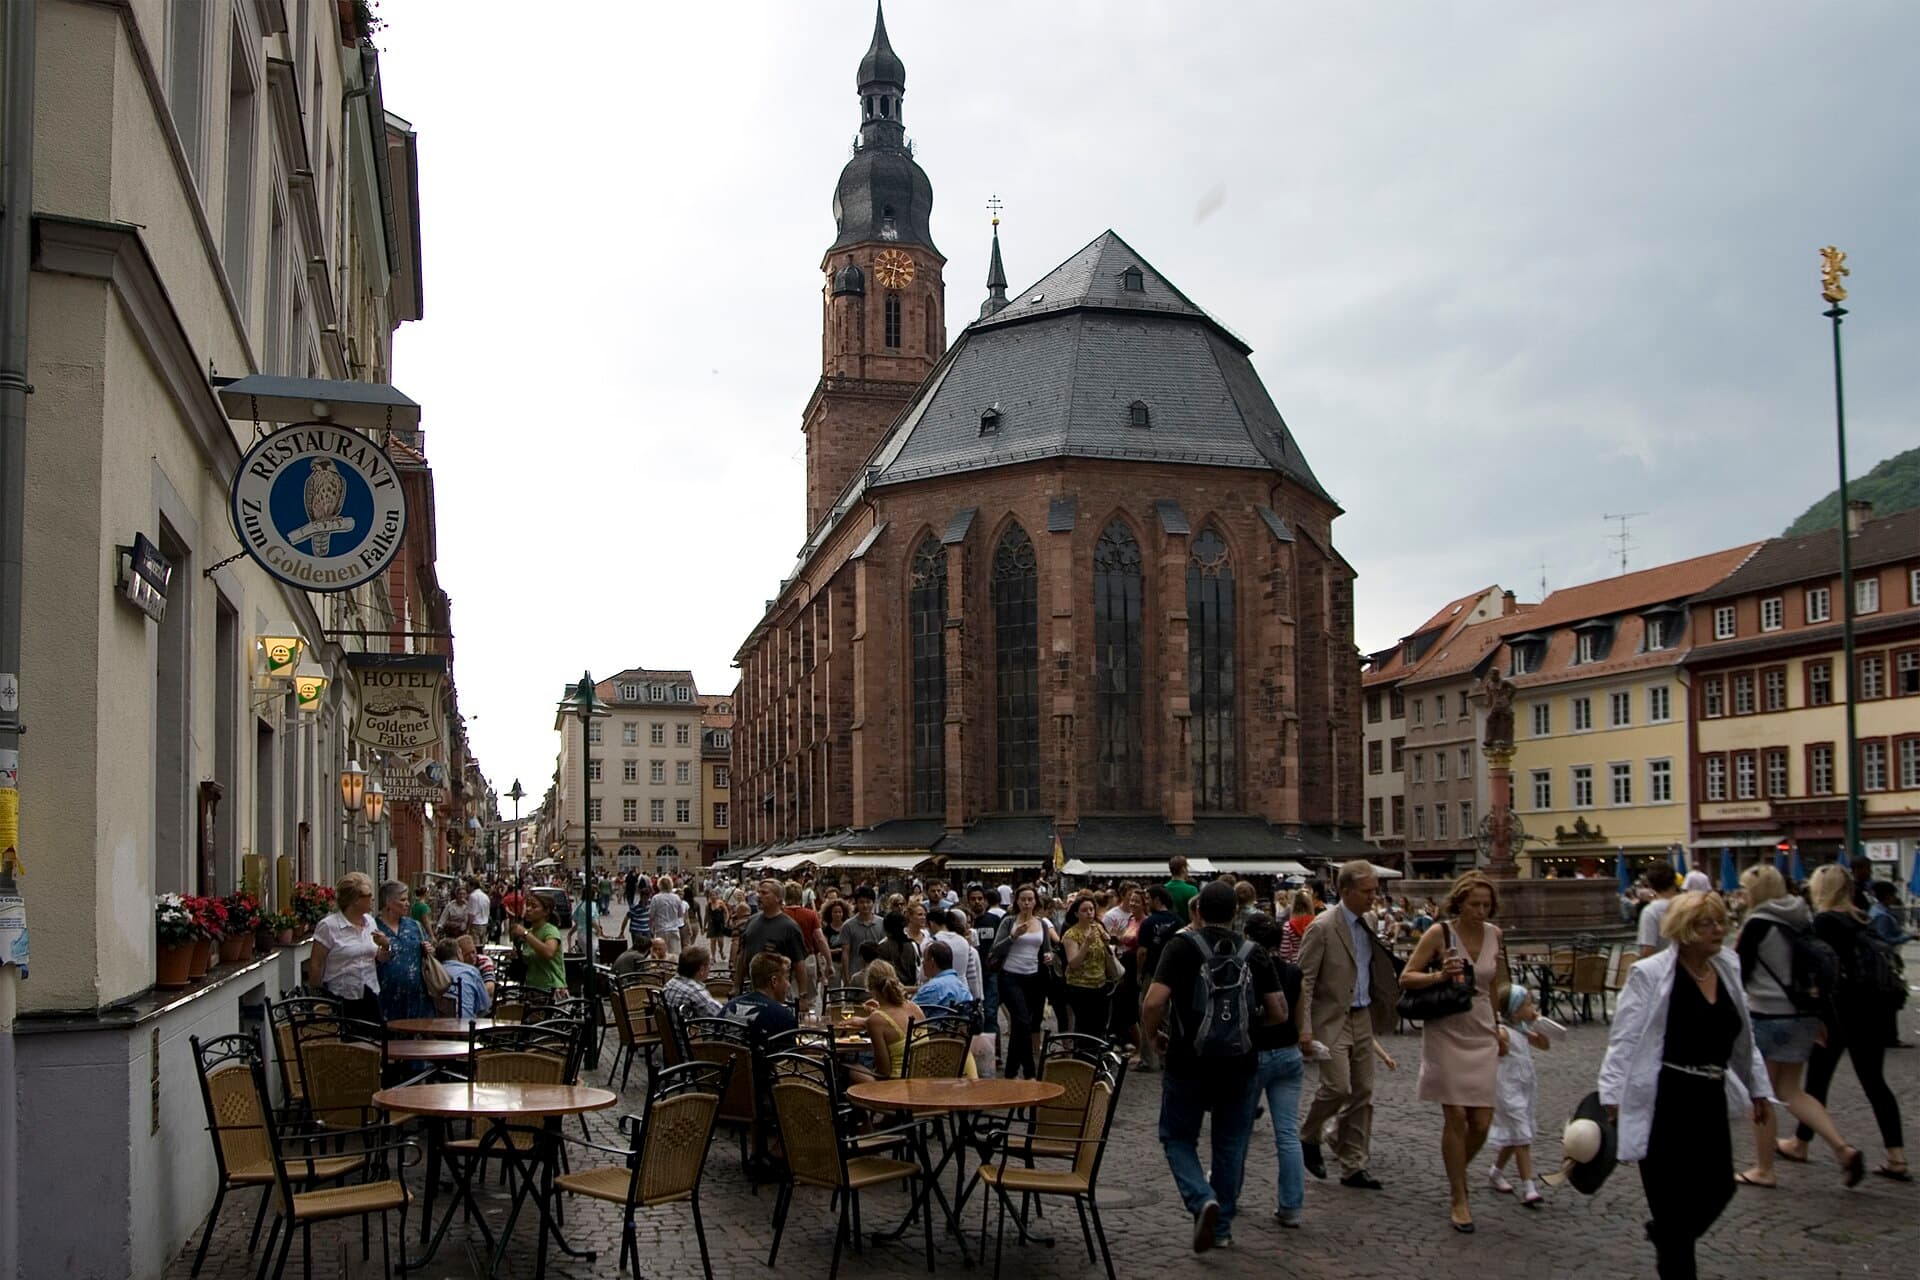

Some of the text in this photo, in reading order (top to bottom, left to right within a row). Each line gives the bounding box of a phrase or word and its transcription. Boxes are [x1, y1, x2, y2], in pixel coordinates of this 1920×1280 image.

[249, 431, 396, 490] RESTAURANT
[242, 498, 400, 583] Zum Goldenen Falken
[363, 671, 434, 688] HOTEL
[366, 717, 430, 733] Goldener
[378, 733, 417, 746] Falke
